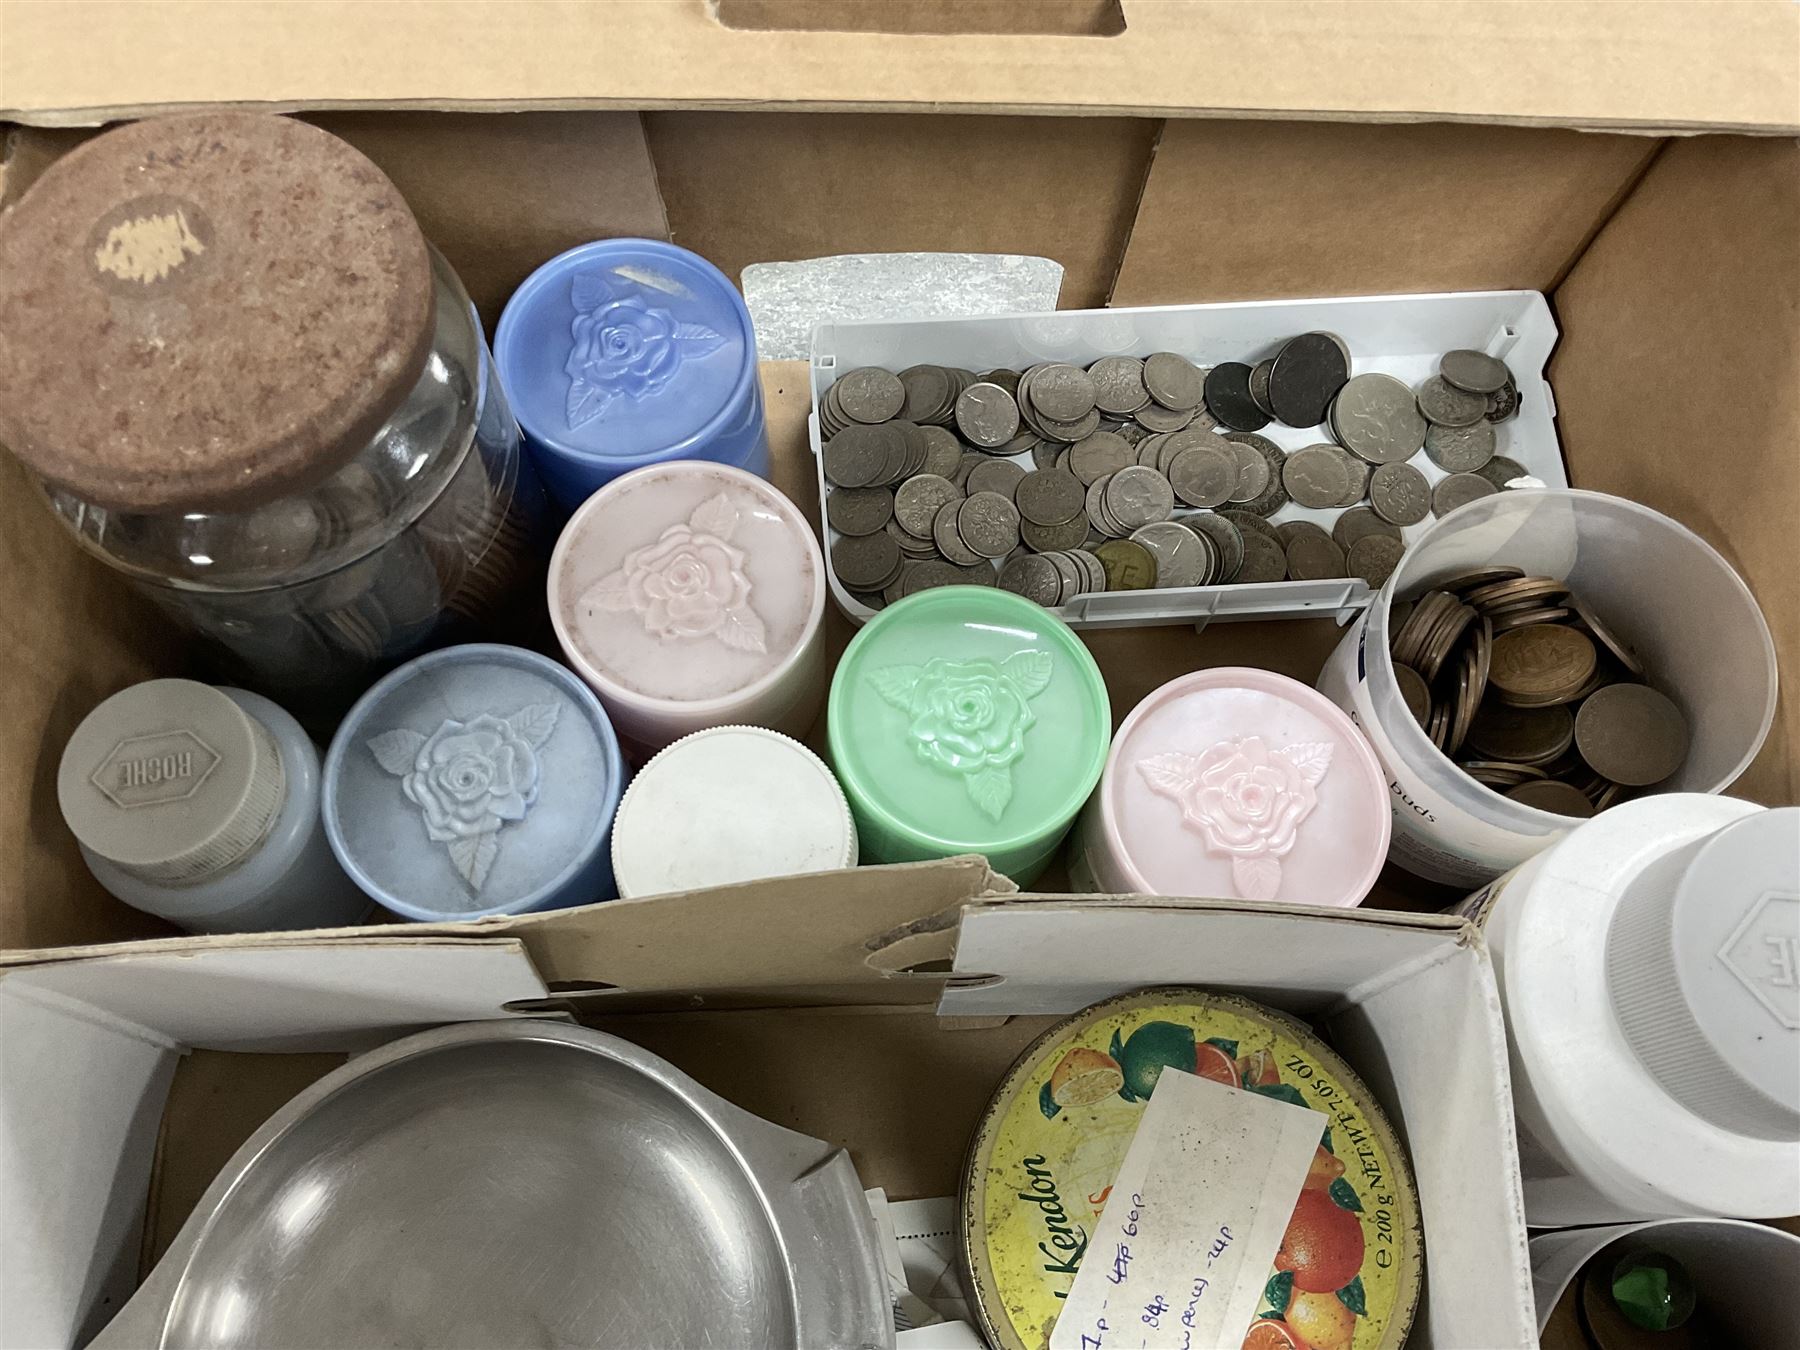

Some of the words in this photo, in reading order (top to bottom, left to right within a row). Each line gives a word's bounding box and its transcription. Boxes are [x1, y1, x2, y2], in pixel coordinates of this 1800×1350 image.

[119, 752, 192, 787] ROCHE
[1390, 781, 1437, 823] buds
[1286, 1054, 1314, 1079] OZ
[1311, 1079, 1343, 1111] 7.05
[1337, 1113, 1368, 1145] WT
[1356, 1146, 1386, 1190] NET
[1018, 1154, 1087, 1273] Kendon
[1379, 1194, 1394, 1207] g
[1377, 1210, 1393, 1245] 200
